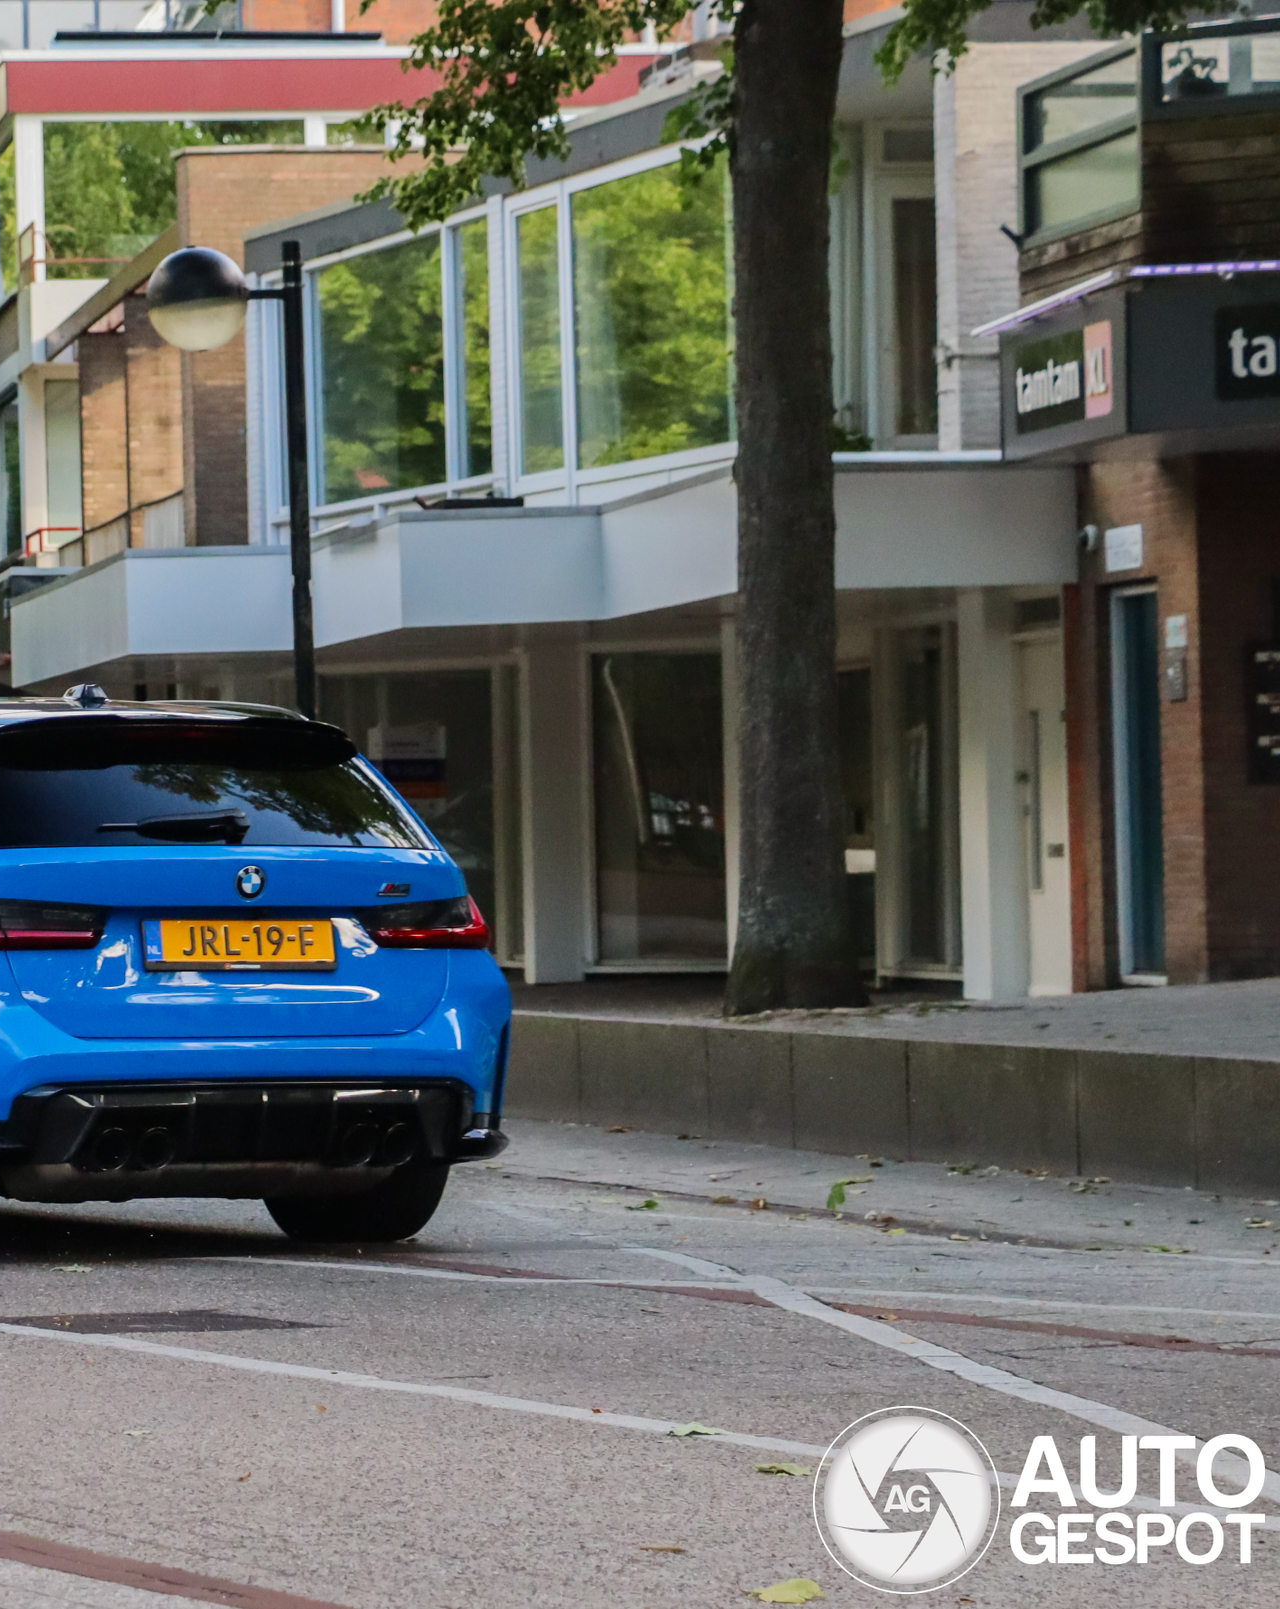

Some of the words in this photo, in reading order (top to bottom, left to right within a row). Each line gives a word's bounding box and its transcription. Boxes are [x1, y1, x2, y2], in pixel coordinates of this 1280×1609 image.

[1016, 357, 1080, 414] tamtam
[1088, 346, 1108, 397] XL
[147, 945, 161, 955] NL
[182, 924, 315, 956] JRL-19-F
